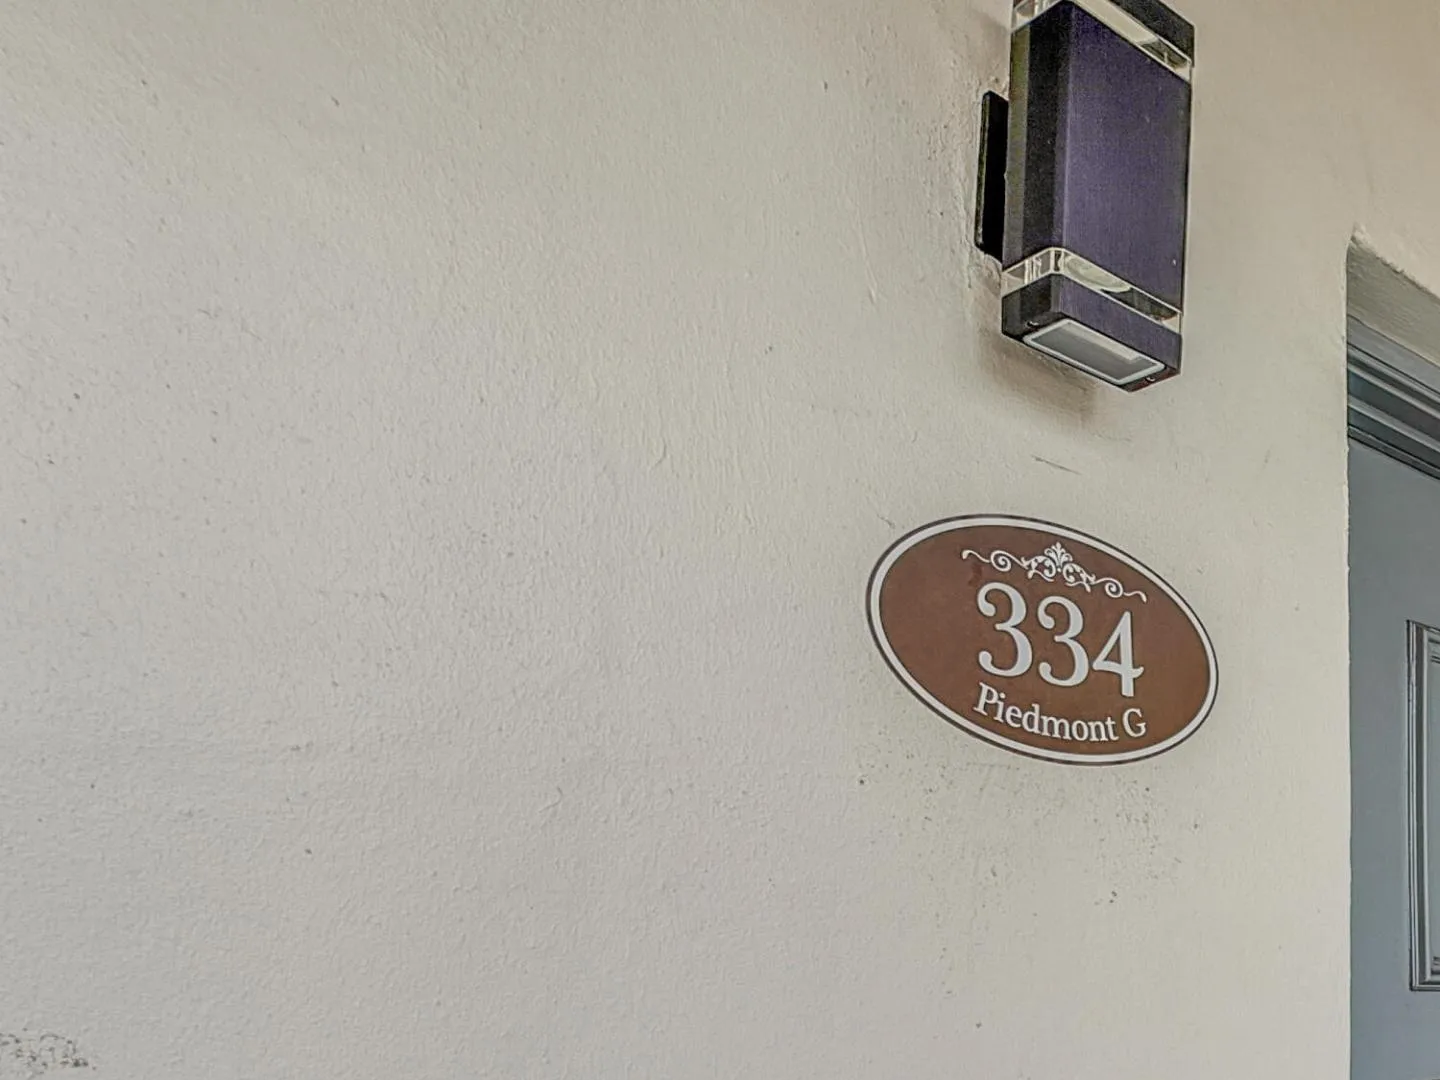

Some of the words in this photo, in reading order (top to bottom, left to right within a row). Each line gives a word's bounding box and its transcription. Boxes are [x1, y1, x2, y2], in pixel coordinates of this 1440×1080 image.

[976, 581, 1145, 698] 334
[973, 681, 1119, 742] Piedmont
[1122, 707, 1147, 738] G
